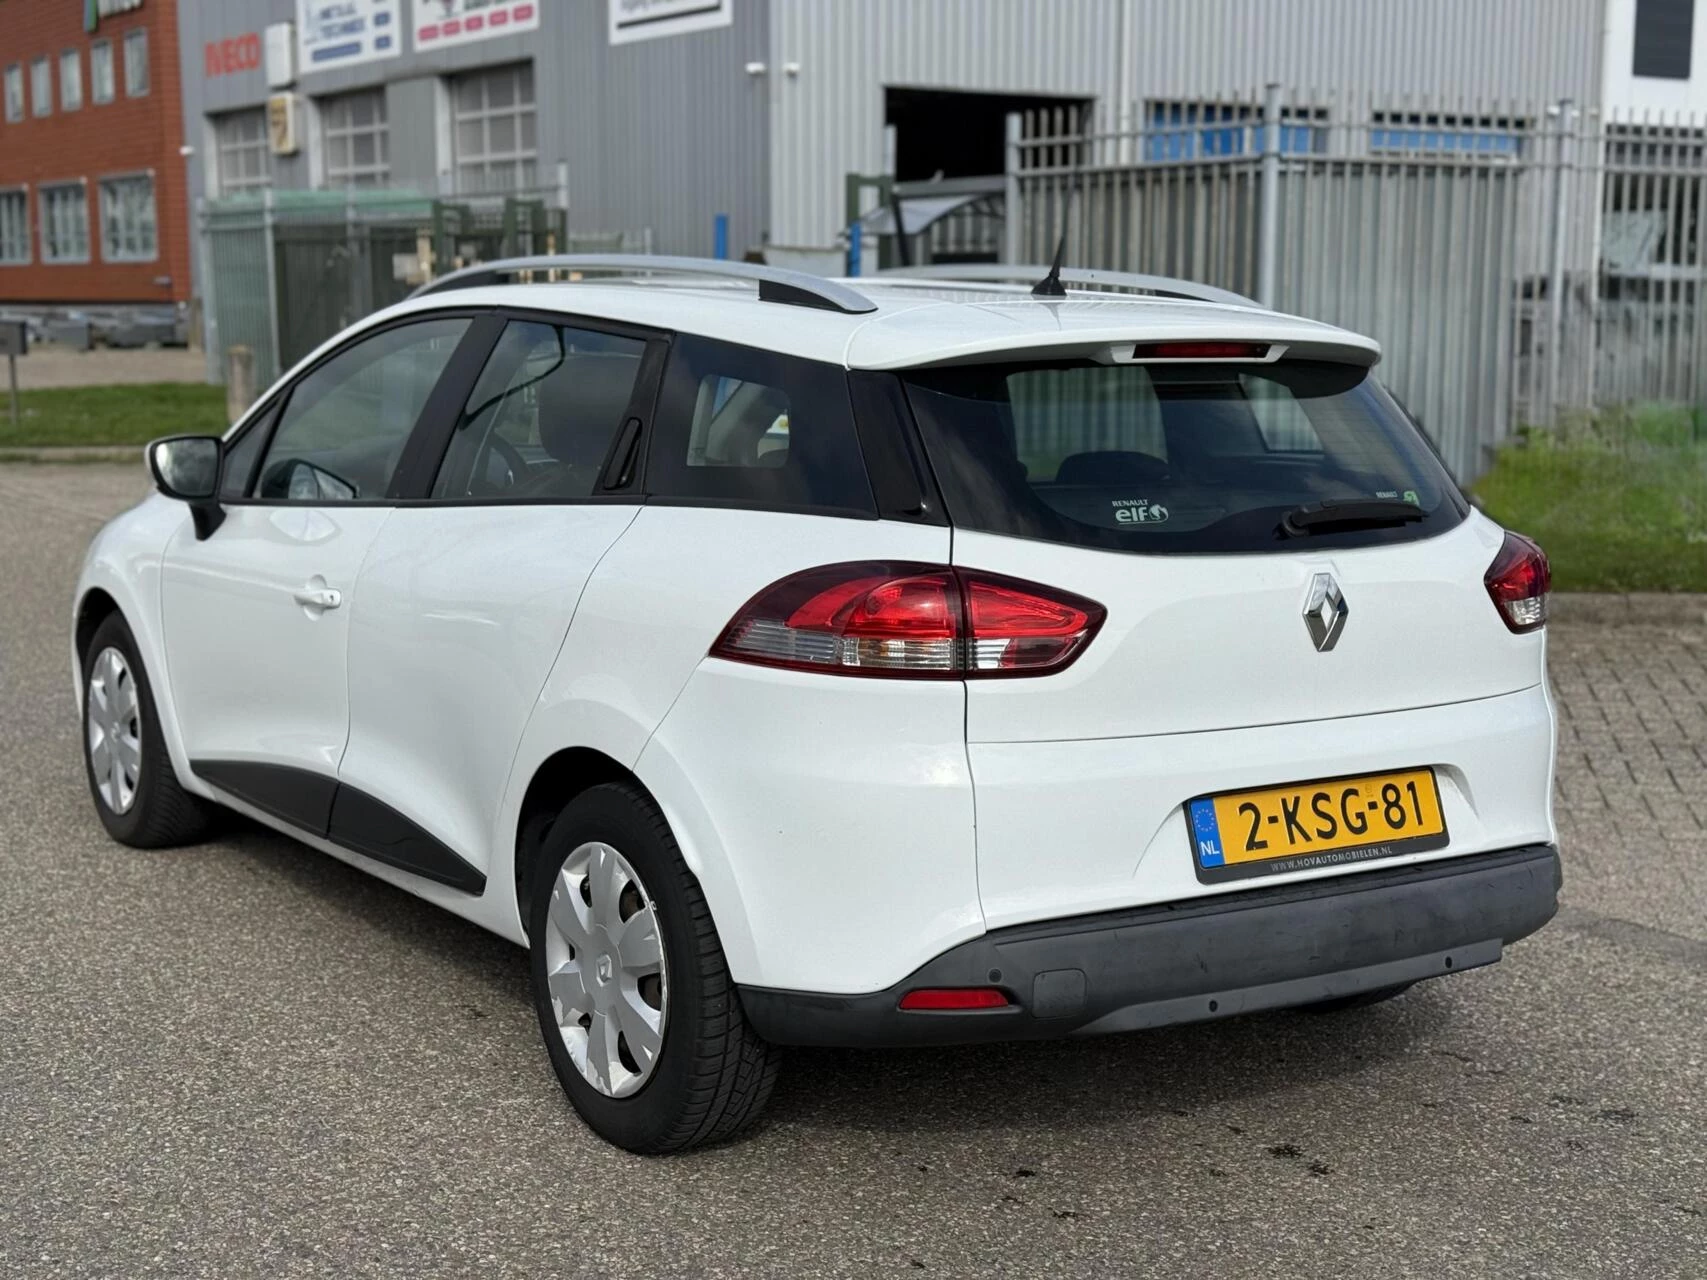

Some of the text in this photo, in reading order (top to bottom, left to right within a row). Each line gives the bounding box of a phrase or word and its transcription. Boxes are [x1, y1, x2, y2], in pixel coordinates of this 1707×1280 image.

[204, 32, 260, 78] IVECO
[1111, 499, 1148, 507] RENAULT
[1238, 780, 1424, 852] 2-KSG-81
[1200, 840, 1220, 856] NL
